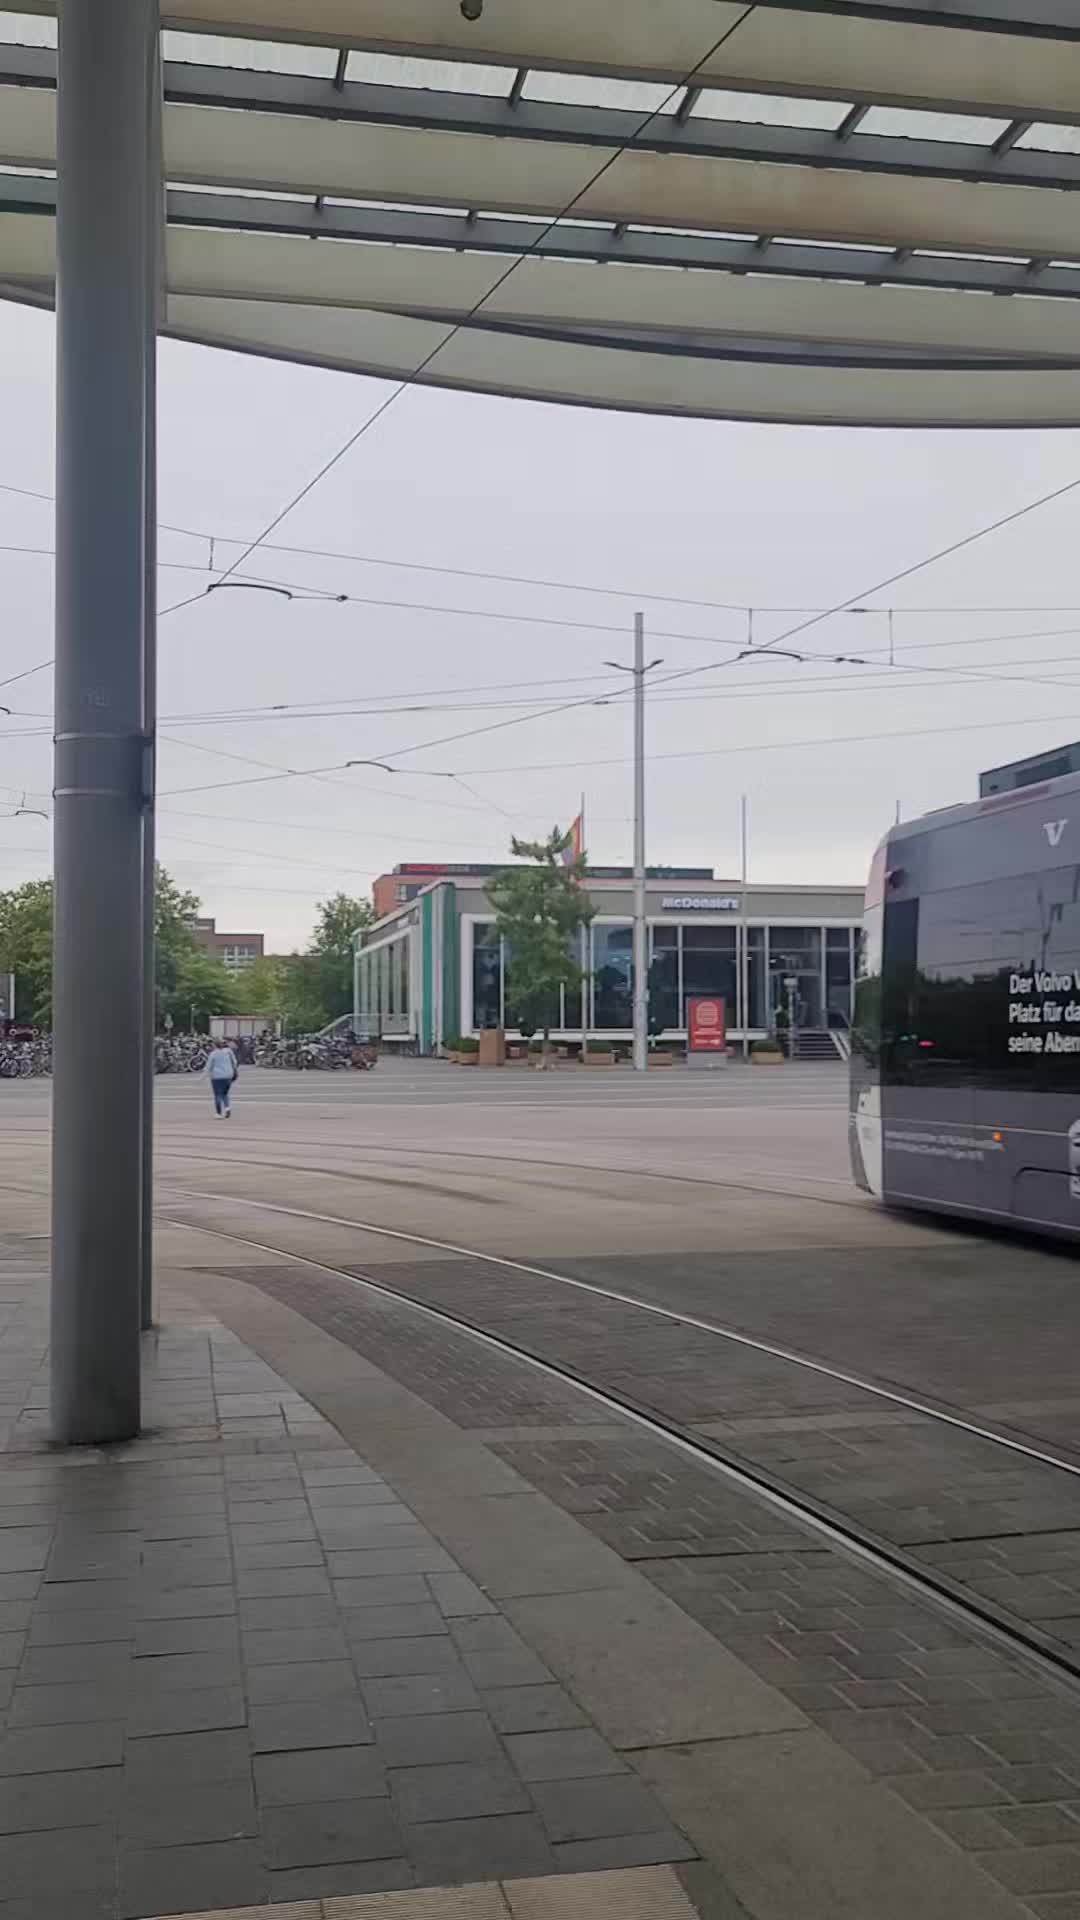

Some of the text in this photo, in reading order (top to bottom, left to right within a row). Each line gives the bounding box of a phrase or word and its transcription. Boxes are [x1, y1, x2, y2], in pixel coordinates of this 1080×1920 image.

[1009, 974, 1033, 994] Der
[1034, 971, 1072, 992] Volvo
[1008, 1001, 1041, 1023] Platz
[1043, 1000, 1063, 1022] für
[1008, 1031, 1043, 1053] seine
